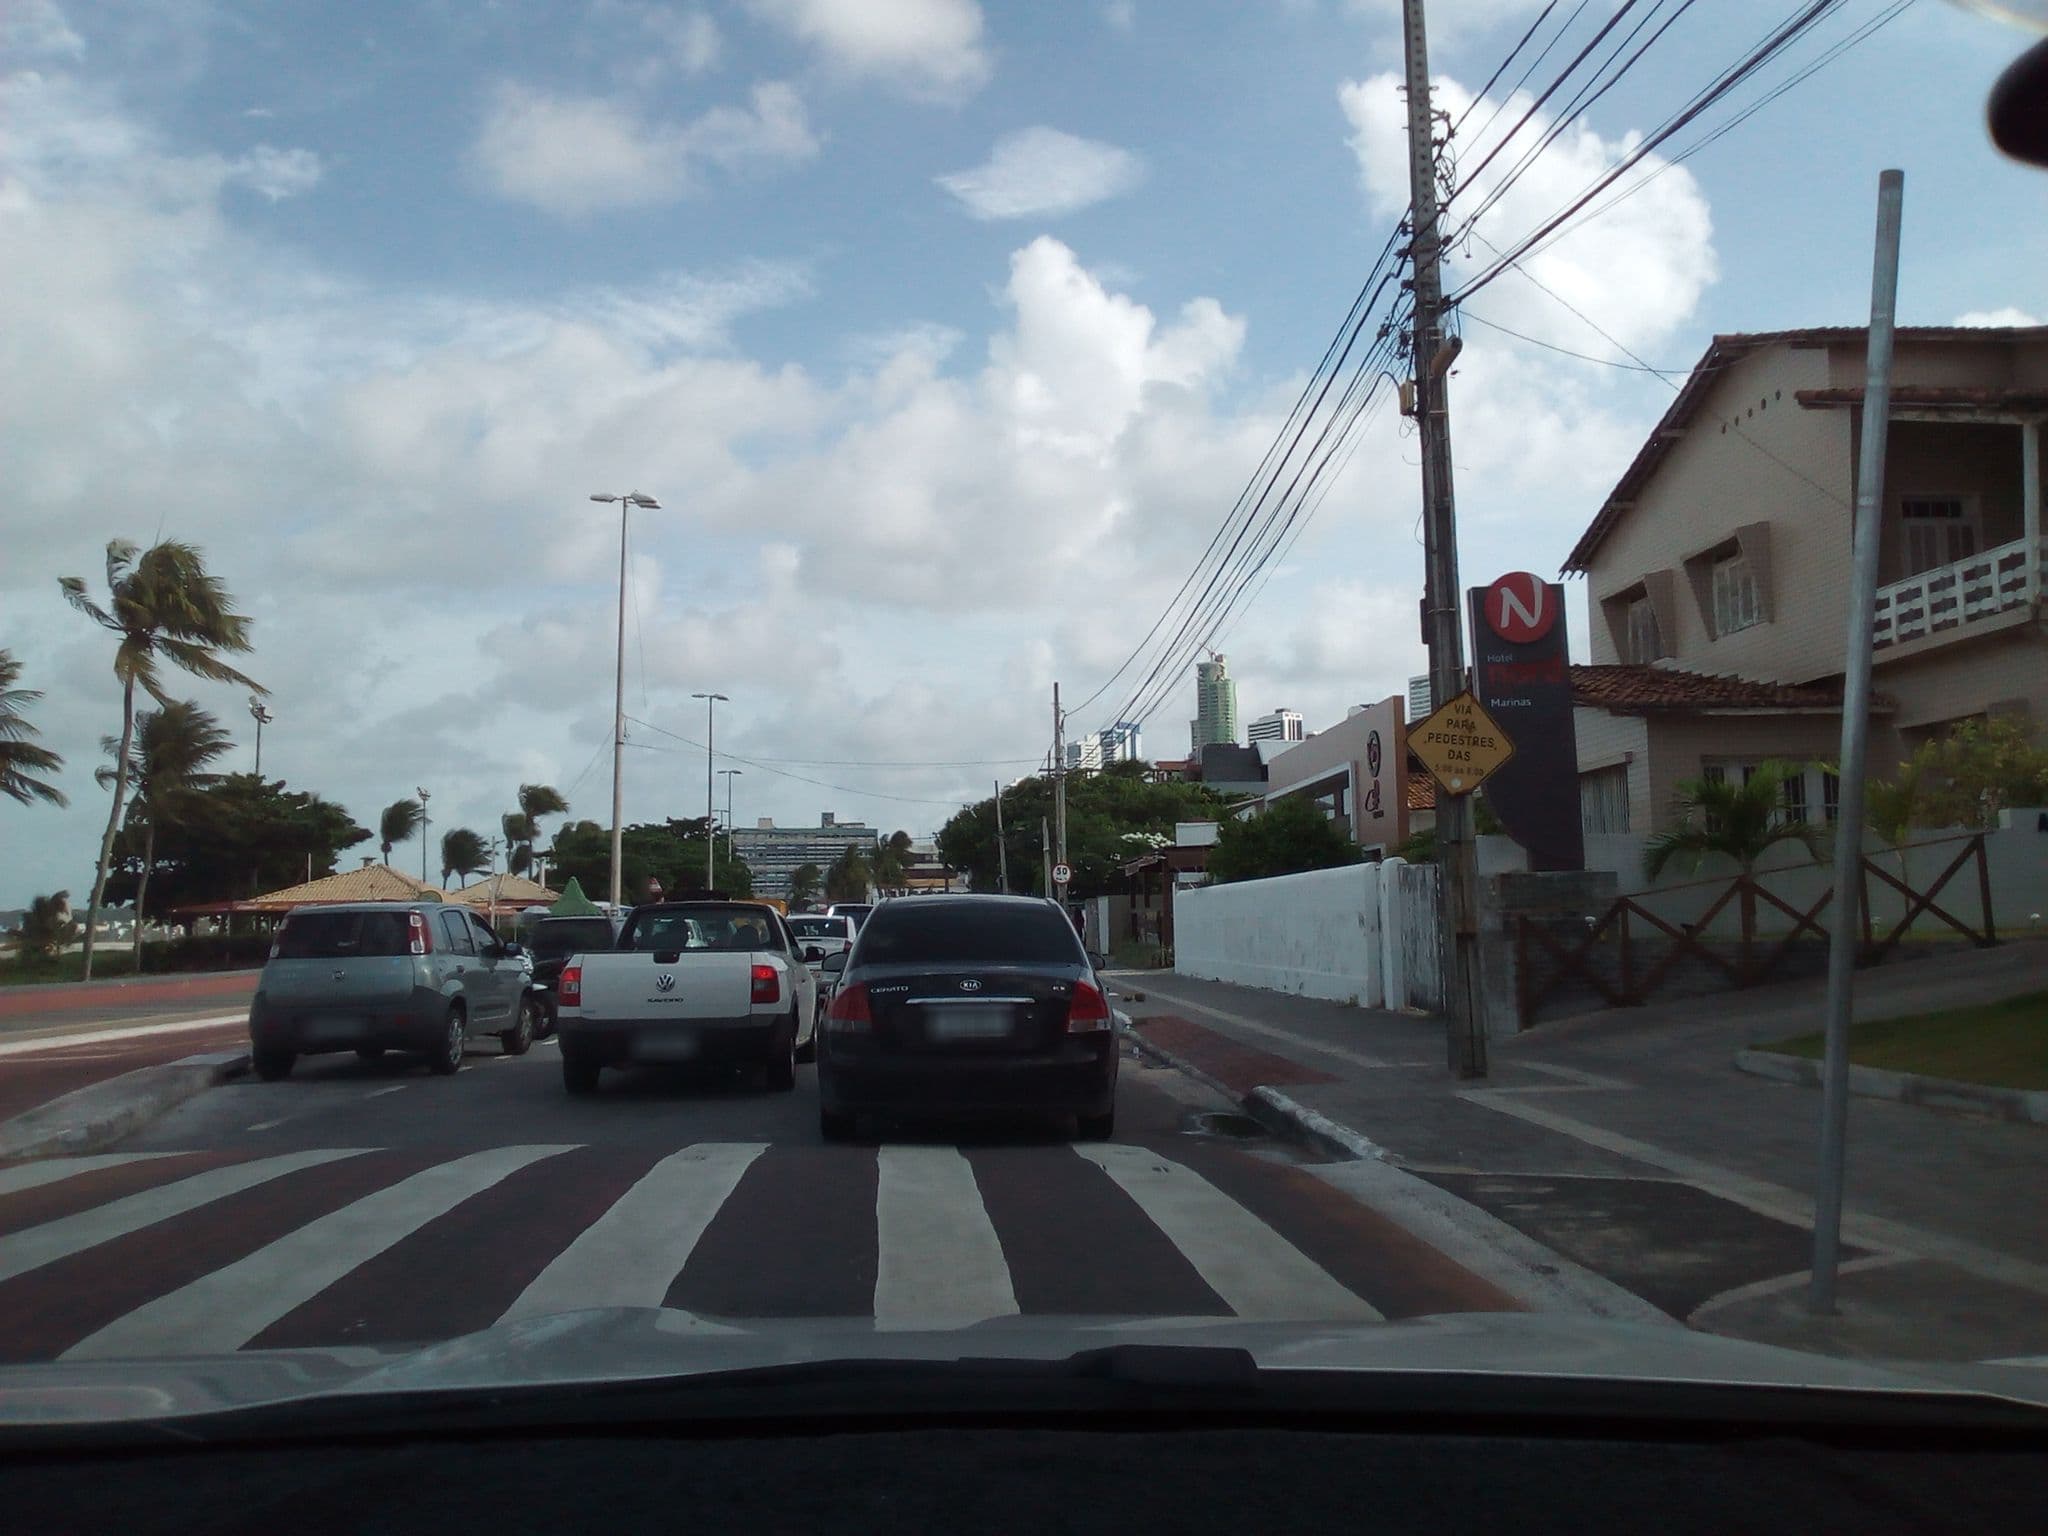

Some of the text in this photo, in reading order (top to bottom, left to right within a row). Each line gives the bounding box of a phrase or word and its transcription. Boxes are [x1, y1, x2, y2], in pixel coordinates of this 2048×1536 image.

[1487, 653, 1513, 663] Hotel
[1454, 703, 1472, 715] VIA
[1490, 698, 1532, 708] Marinas
[1446, 718, 1476, 730] PARA
[1427, 732, 1495, 748] PEDESTRES
[1447, 749, 1471, 762] DAS
